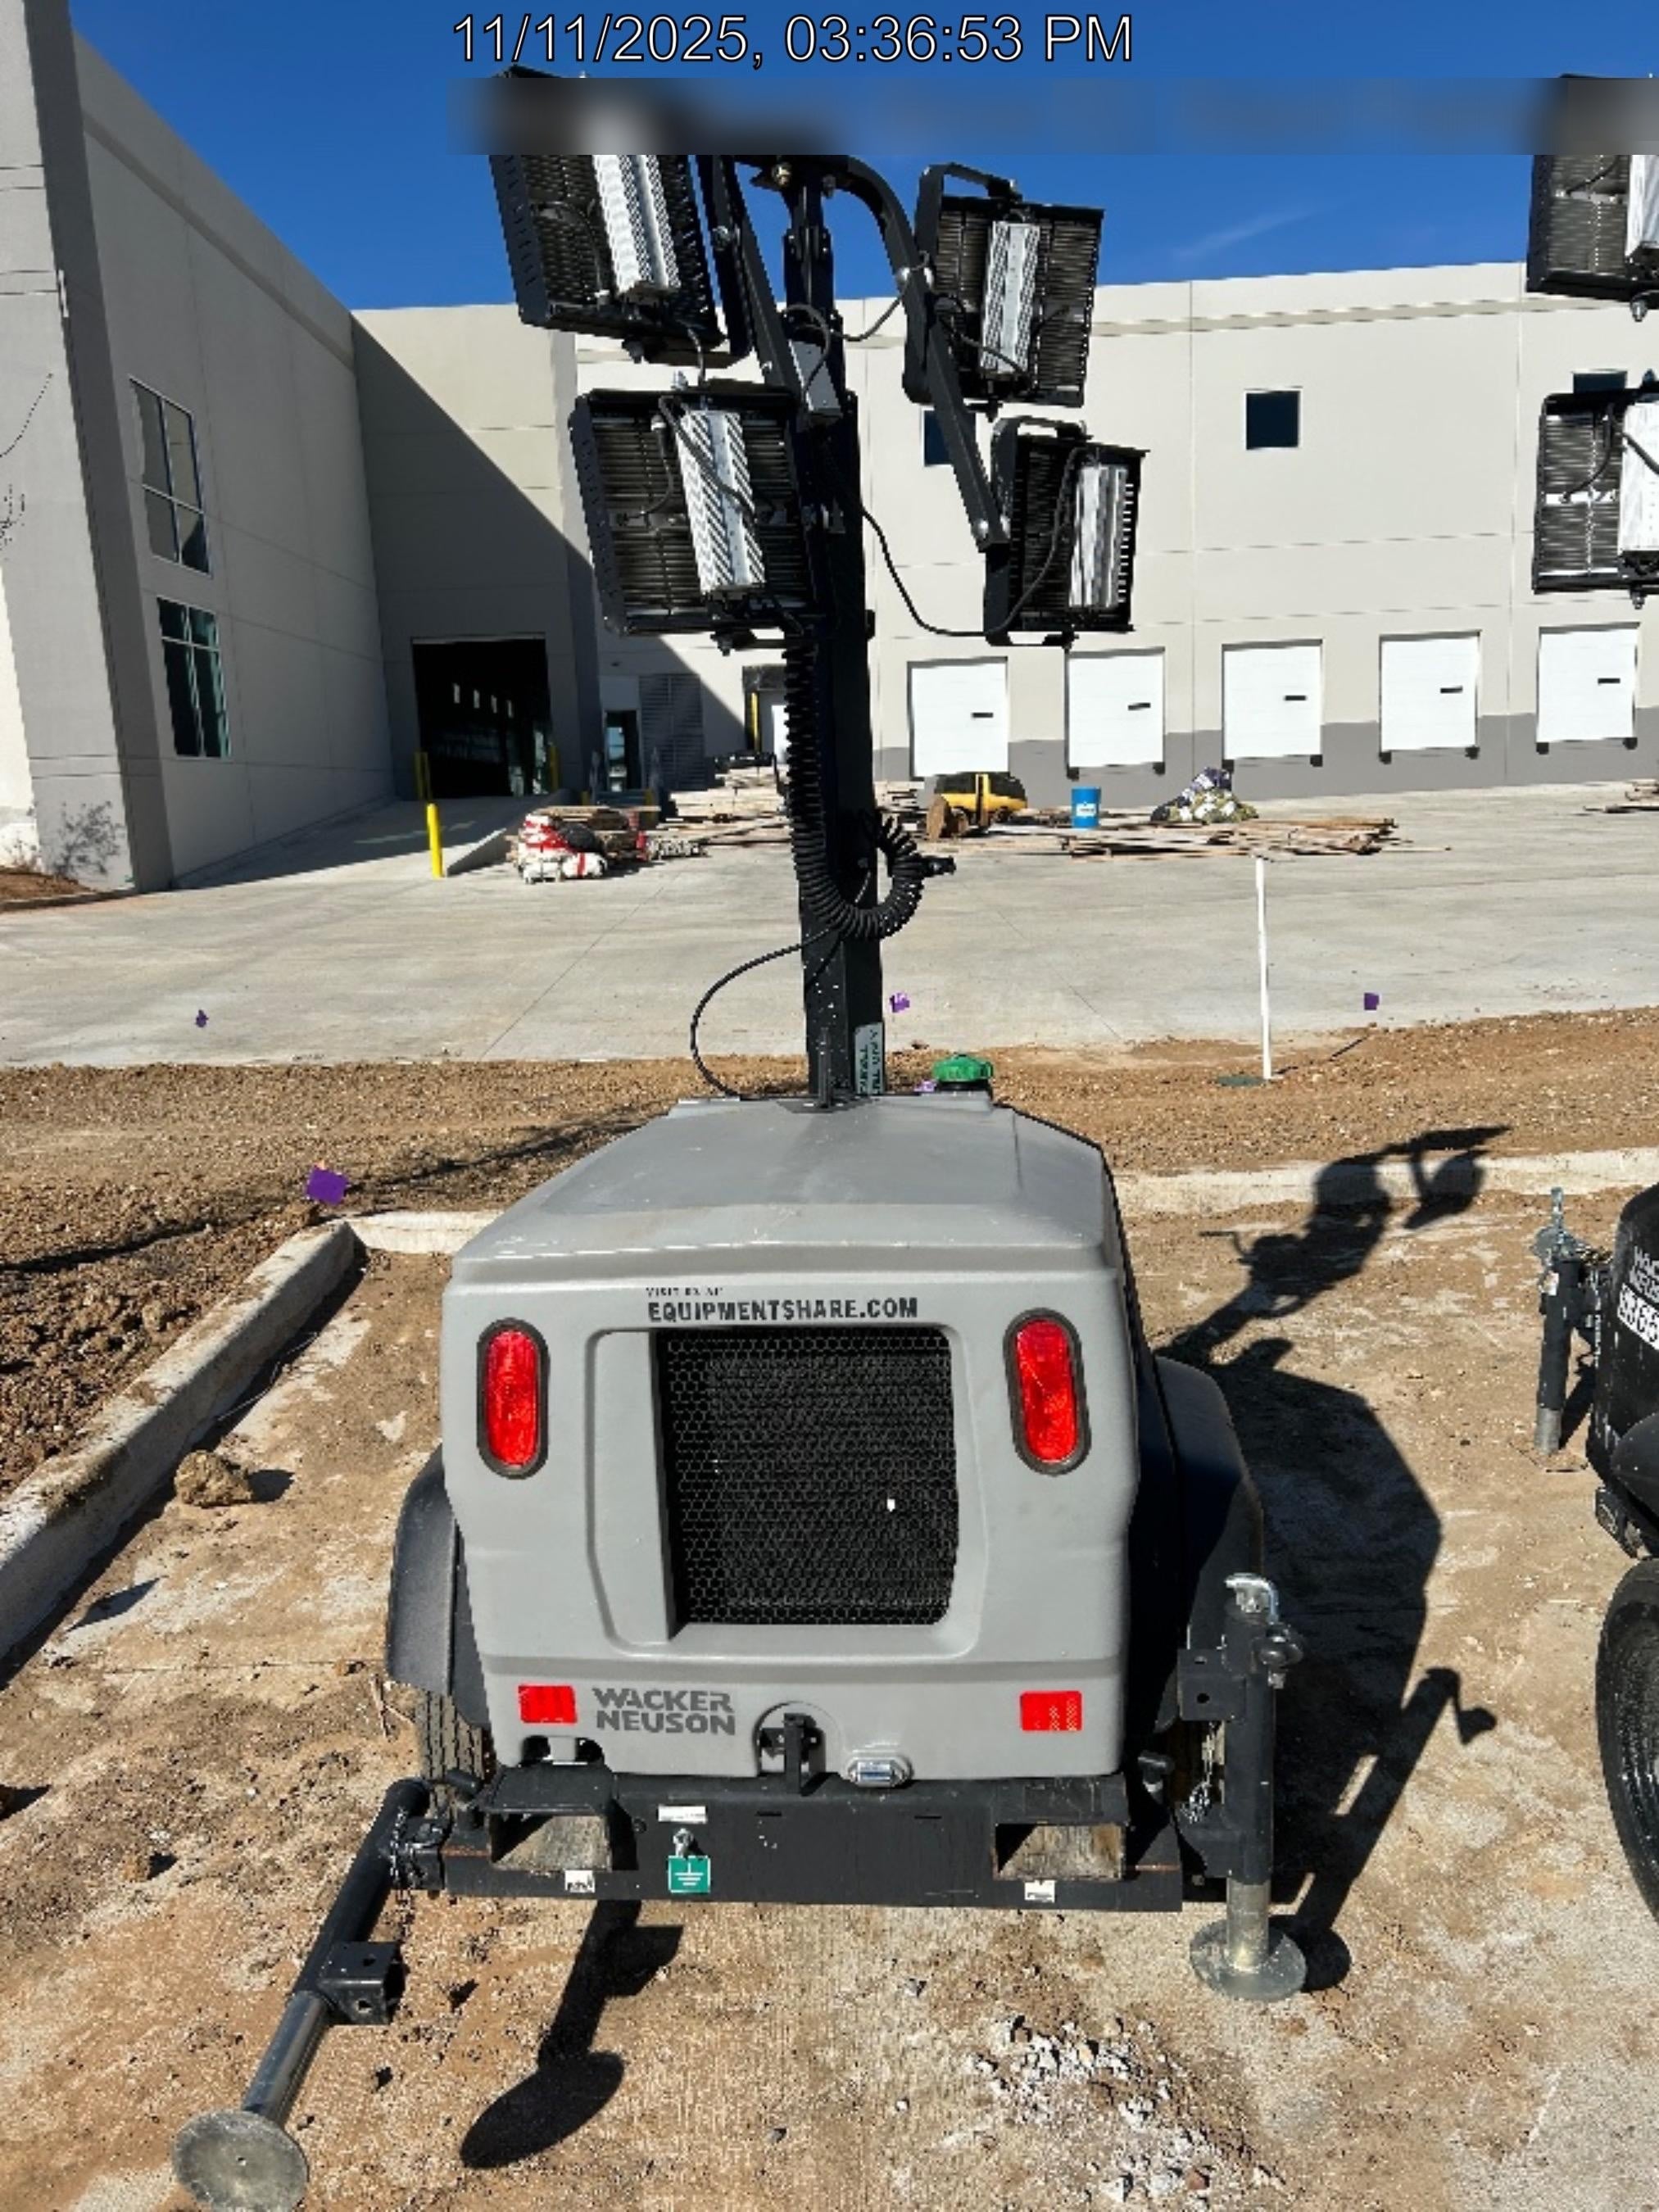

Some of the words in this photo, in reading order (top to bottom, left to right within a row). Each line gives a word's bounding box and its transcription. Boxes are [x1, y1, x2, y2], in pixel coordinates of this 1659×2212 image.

[648, 1298, 918, 1322] EQUIPMENTSHARE.COM
[592, 1688, 735, 1711] WACKER
[596, 1711, 737, 1736] NEUSON
